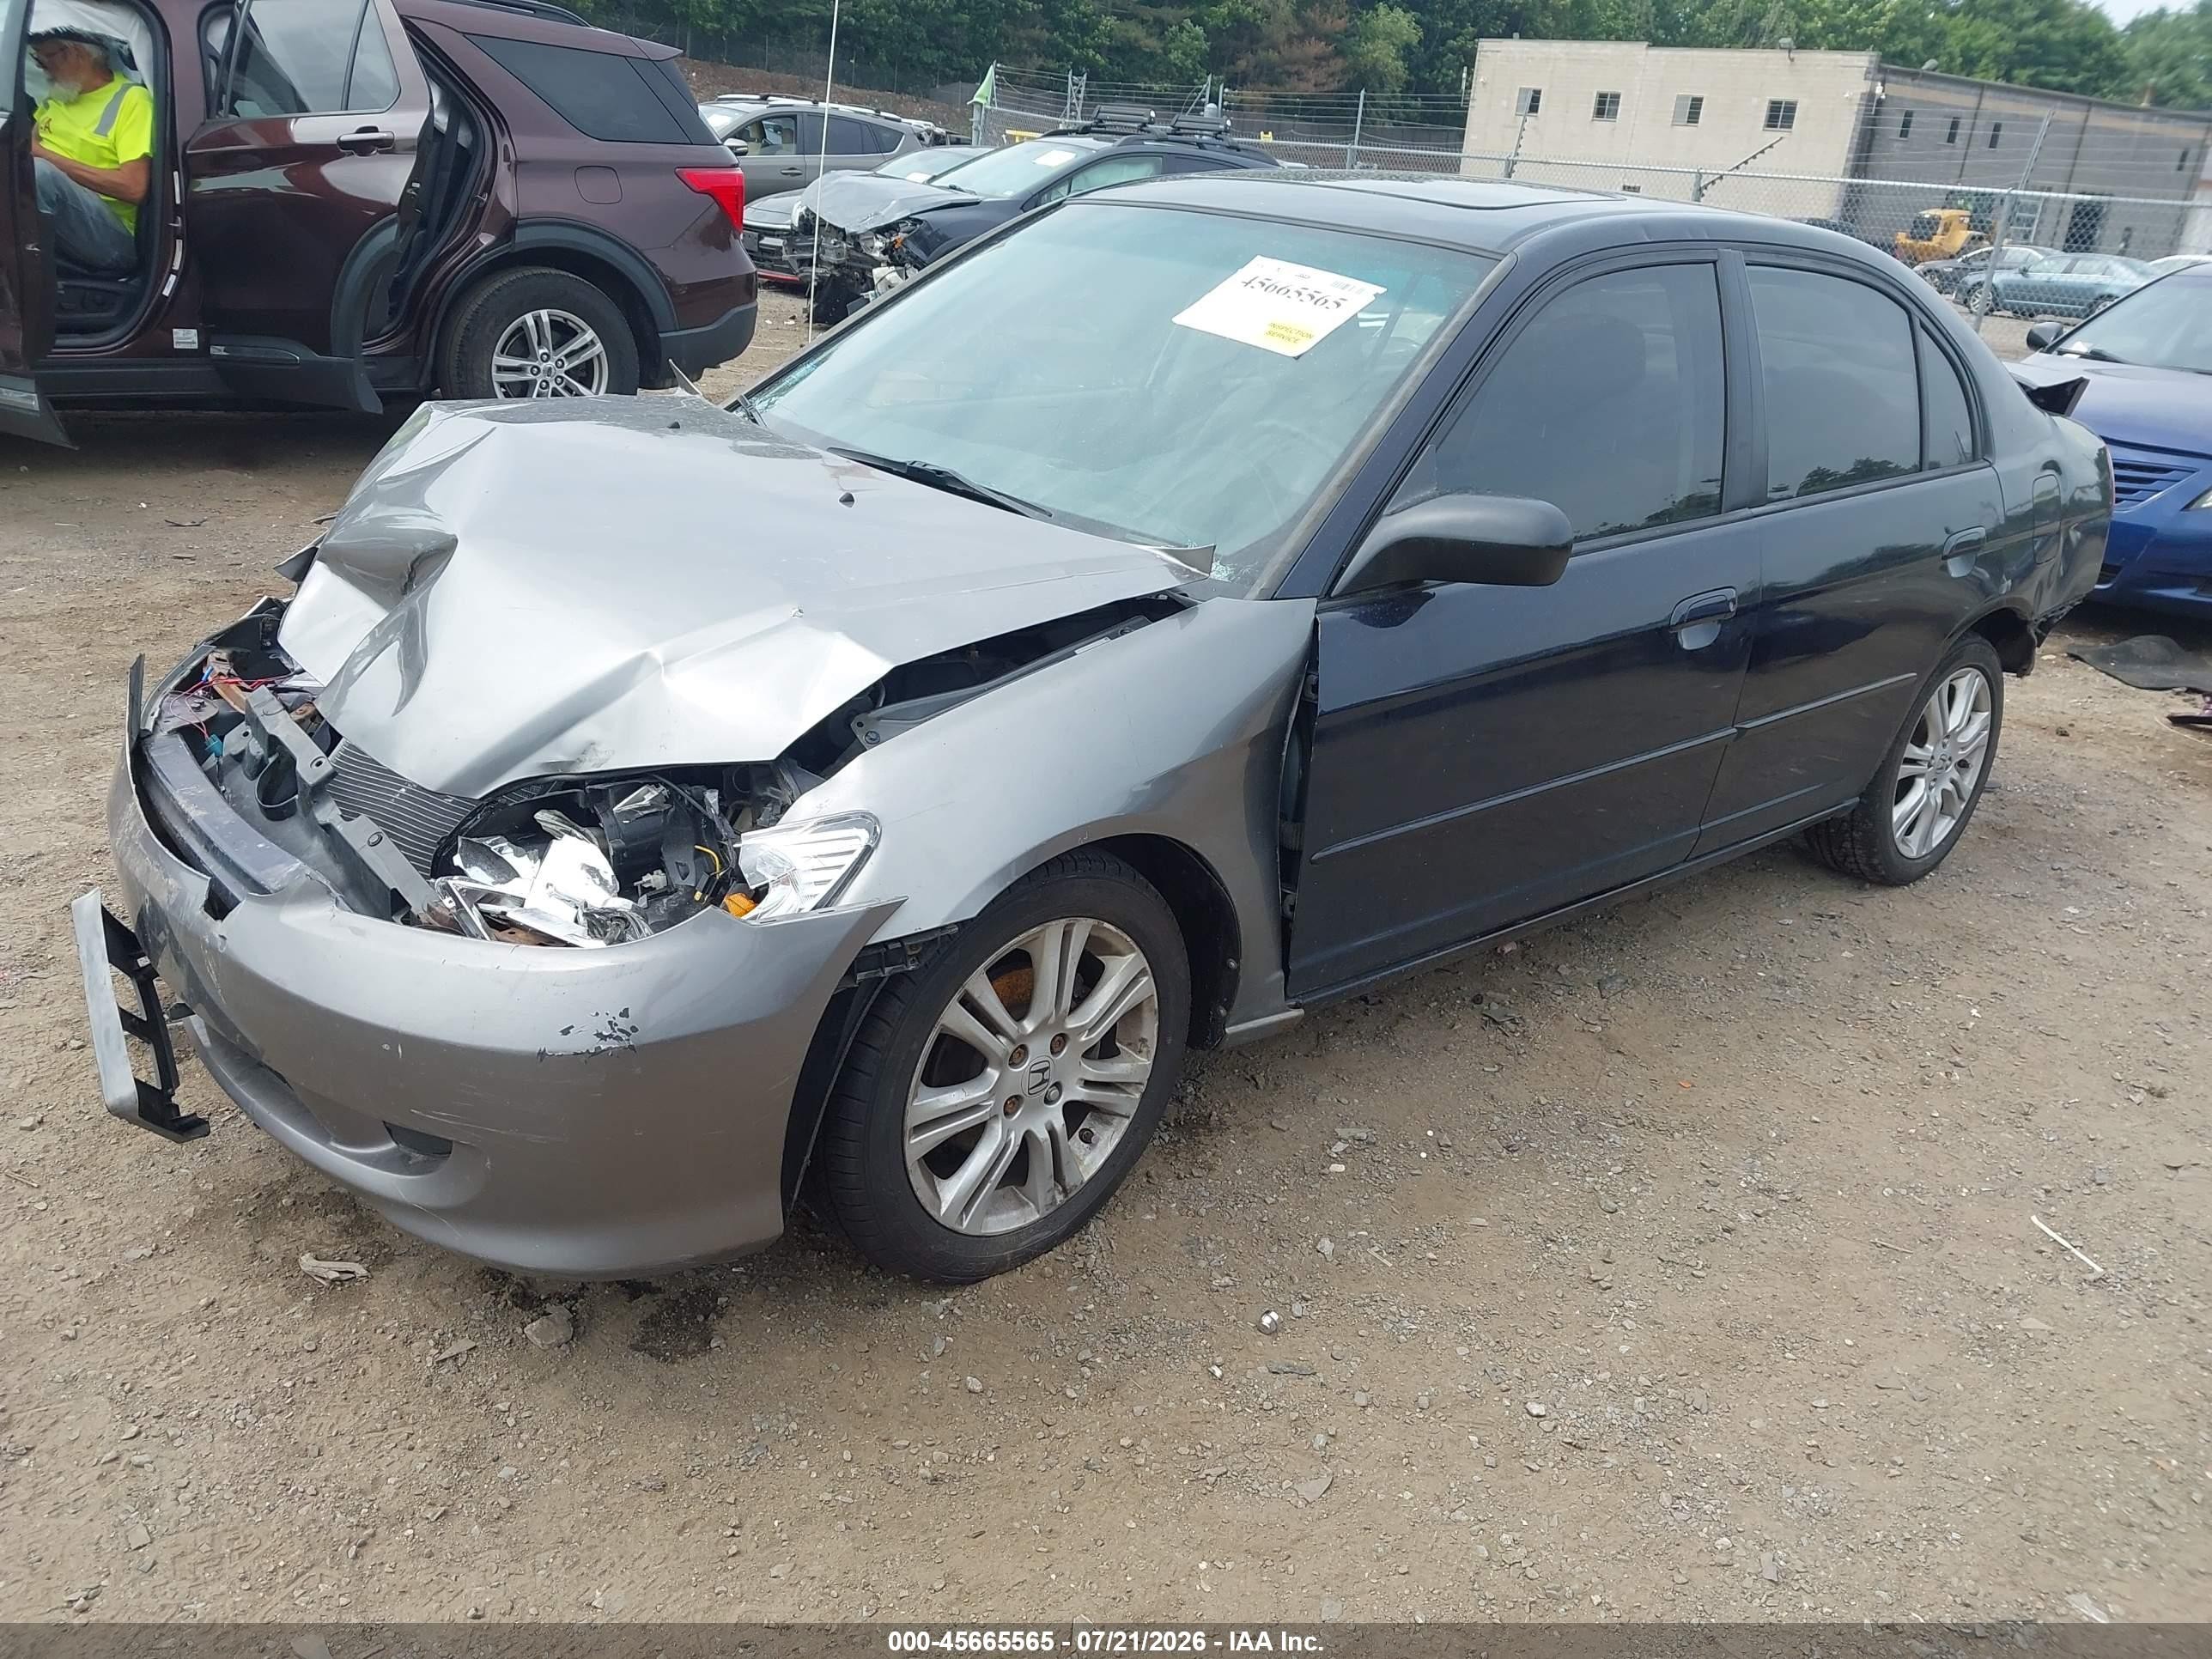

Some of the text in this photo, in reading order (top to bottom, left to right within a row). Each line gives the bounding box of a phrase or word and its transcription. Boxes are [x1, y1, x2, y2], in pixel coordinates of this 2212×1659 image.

[1241, 276, 1348, 310] 45665565
[1264, 330, 1302, 344] SERVICE
[1268, 322, 1315, 340] INSPECTION
